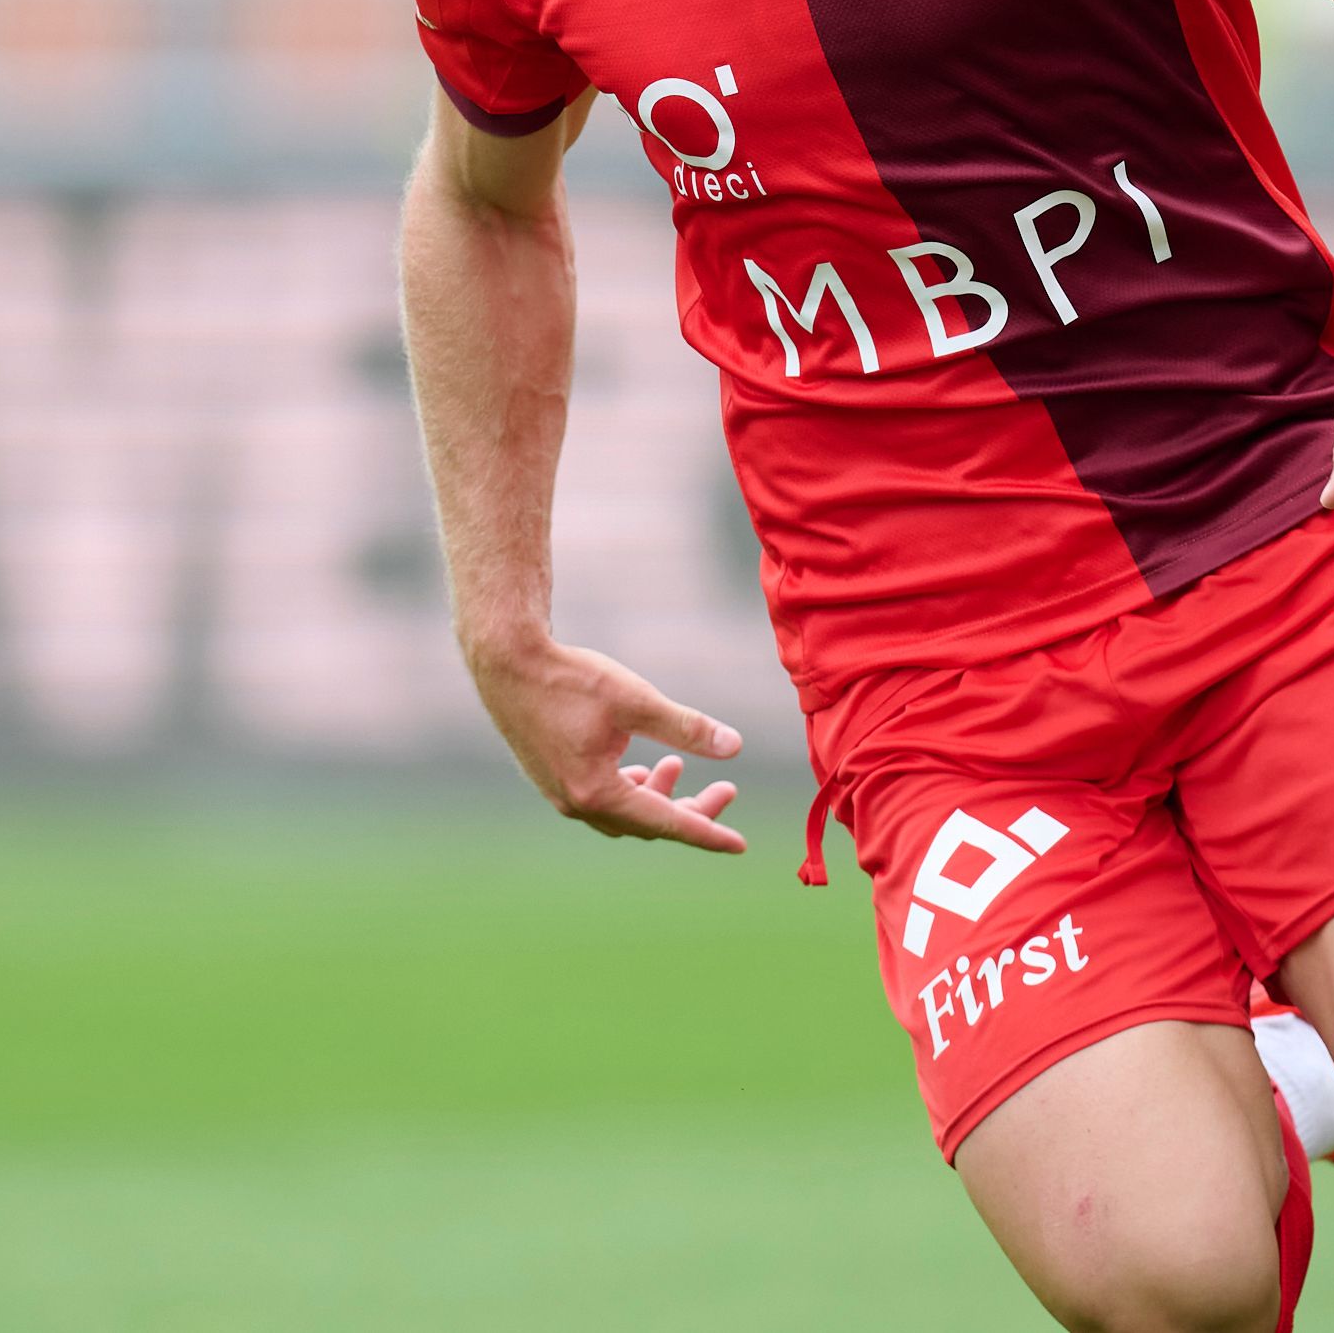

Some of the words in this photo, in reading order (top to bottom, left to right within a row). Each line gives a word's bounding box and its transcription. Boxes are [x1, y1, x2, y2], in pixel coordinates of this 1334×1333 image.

[673, 161, 768, 202] dieci
[743, 160, 1173, 378] MBPI
[918, 913, 1090, 1061] First
